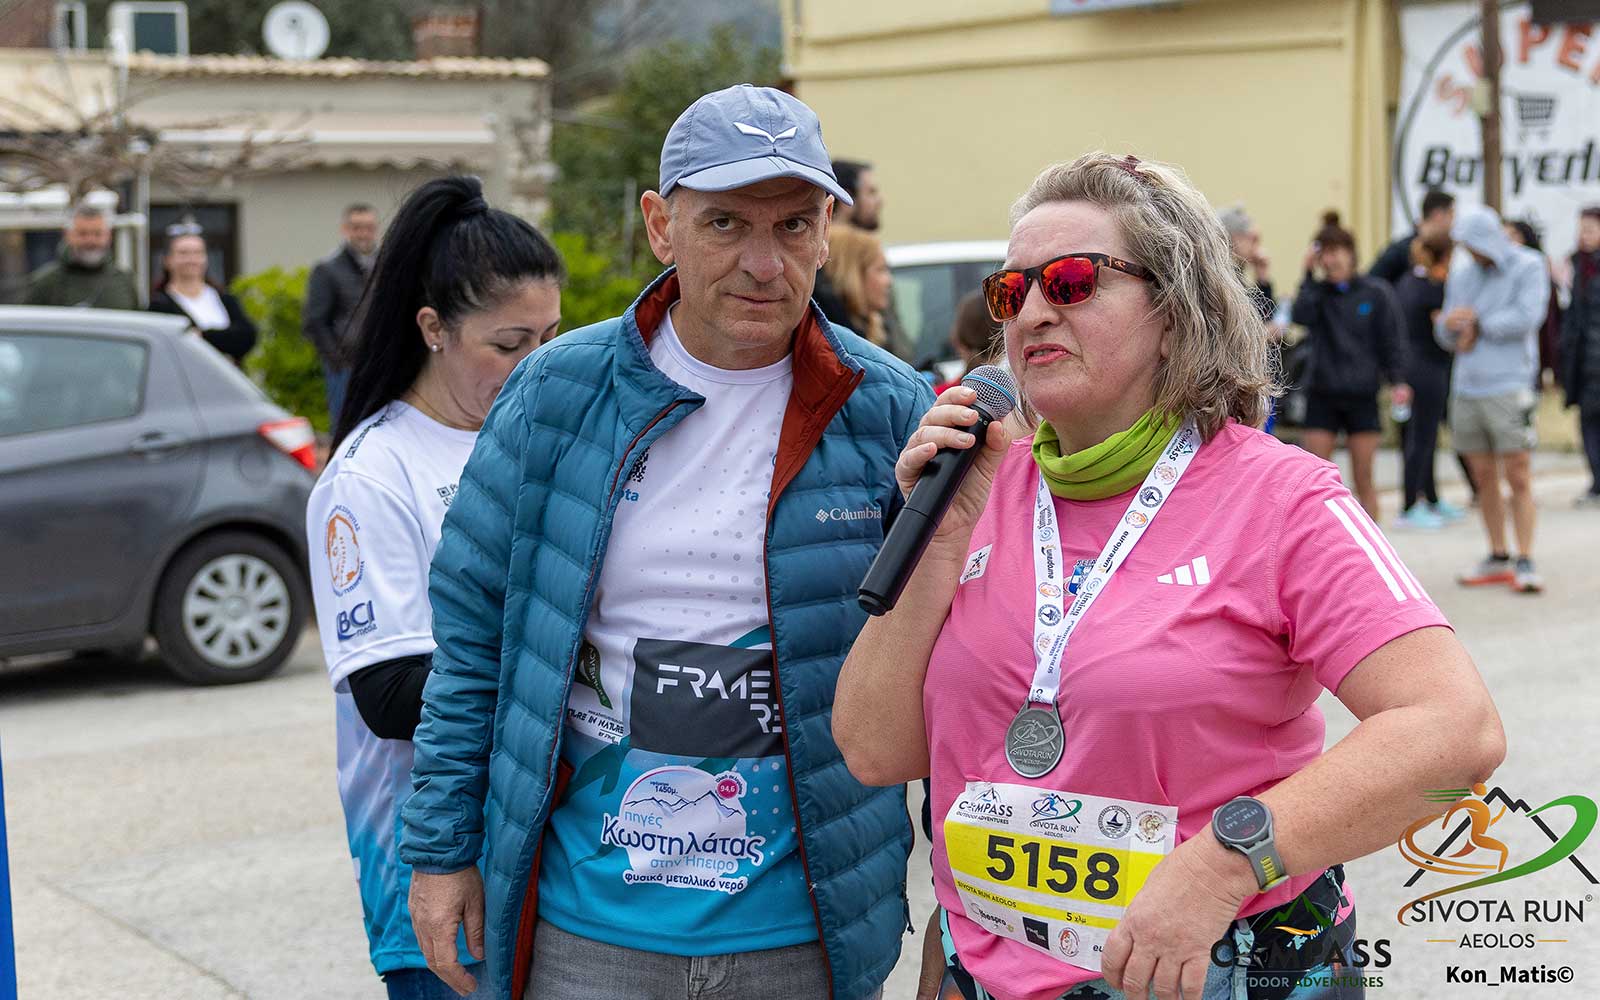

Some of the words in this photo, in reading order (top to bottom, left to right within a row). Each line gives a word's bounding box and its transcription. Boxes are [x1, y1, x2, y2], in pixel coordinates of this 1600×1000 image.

[830, 507, 882, 521] Columbia
[1103, 530, 1129, 568] europrawn
[338, 600, 375, 635] BCI
[656, 663, 771, 699] FRAME
[598, 718, 625, 734] NATURE
[624, 810, 663, 829] πηγές
[1032, 821, 1059, 831] SIVOTA
[602, 815, 762, 864] Κωστηλάτας
[650, 857, 681, 868] στην
[985, 834, 1121, 901] 5158
[624, 872, 663, 883] φυσικό
[665, 873, 717, 889] μεταλλικό
[718, 881, 745, 893] νερό
[991, 895, 1017, 909] AEOLOS
[1066, 912, 1073, 921] 5
